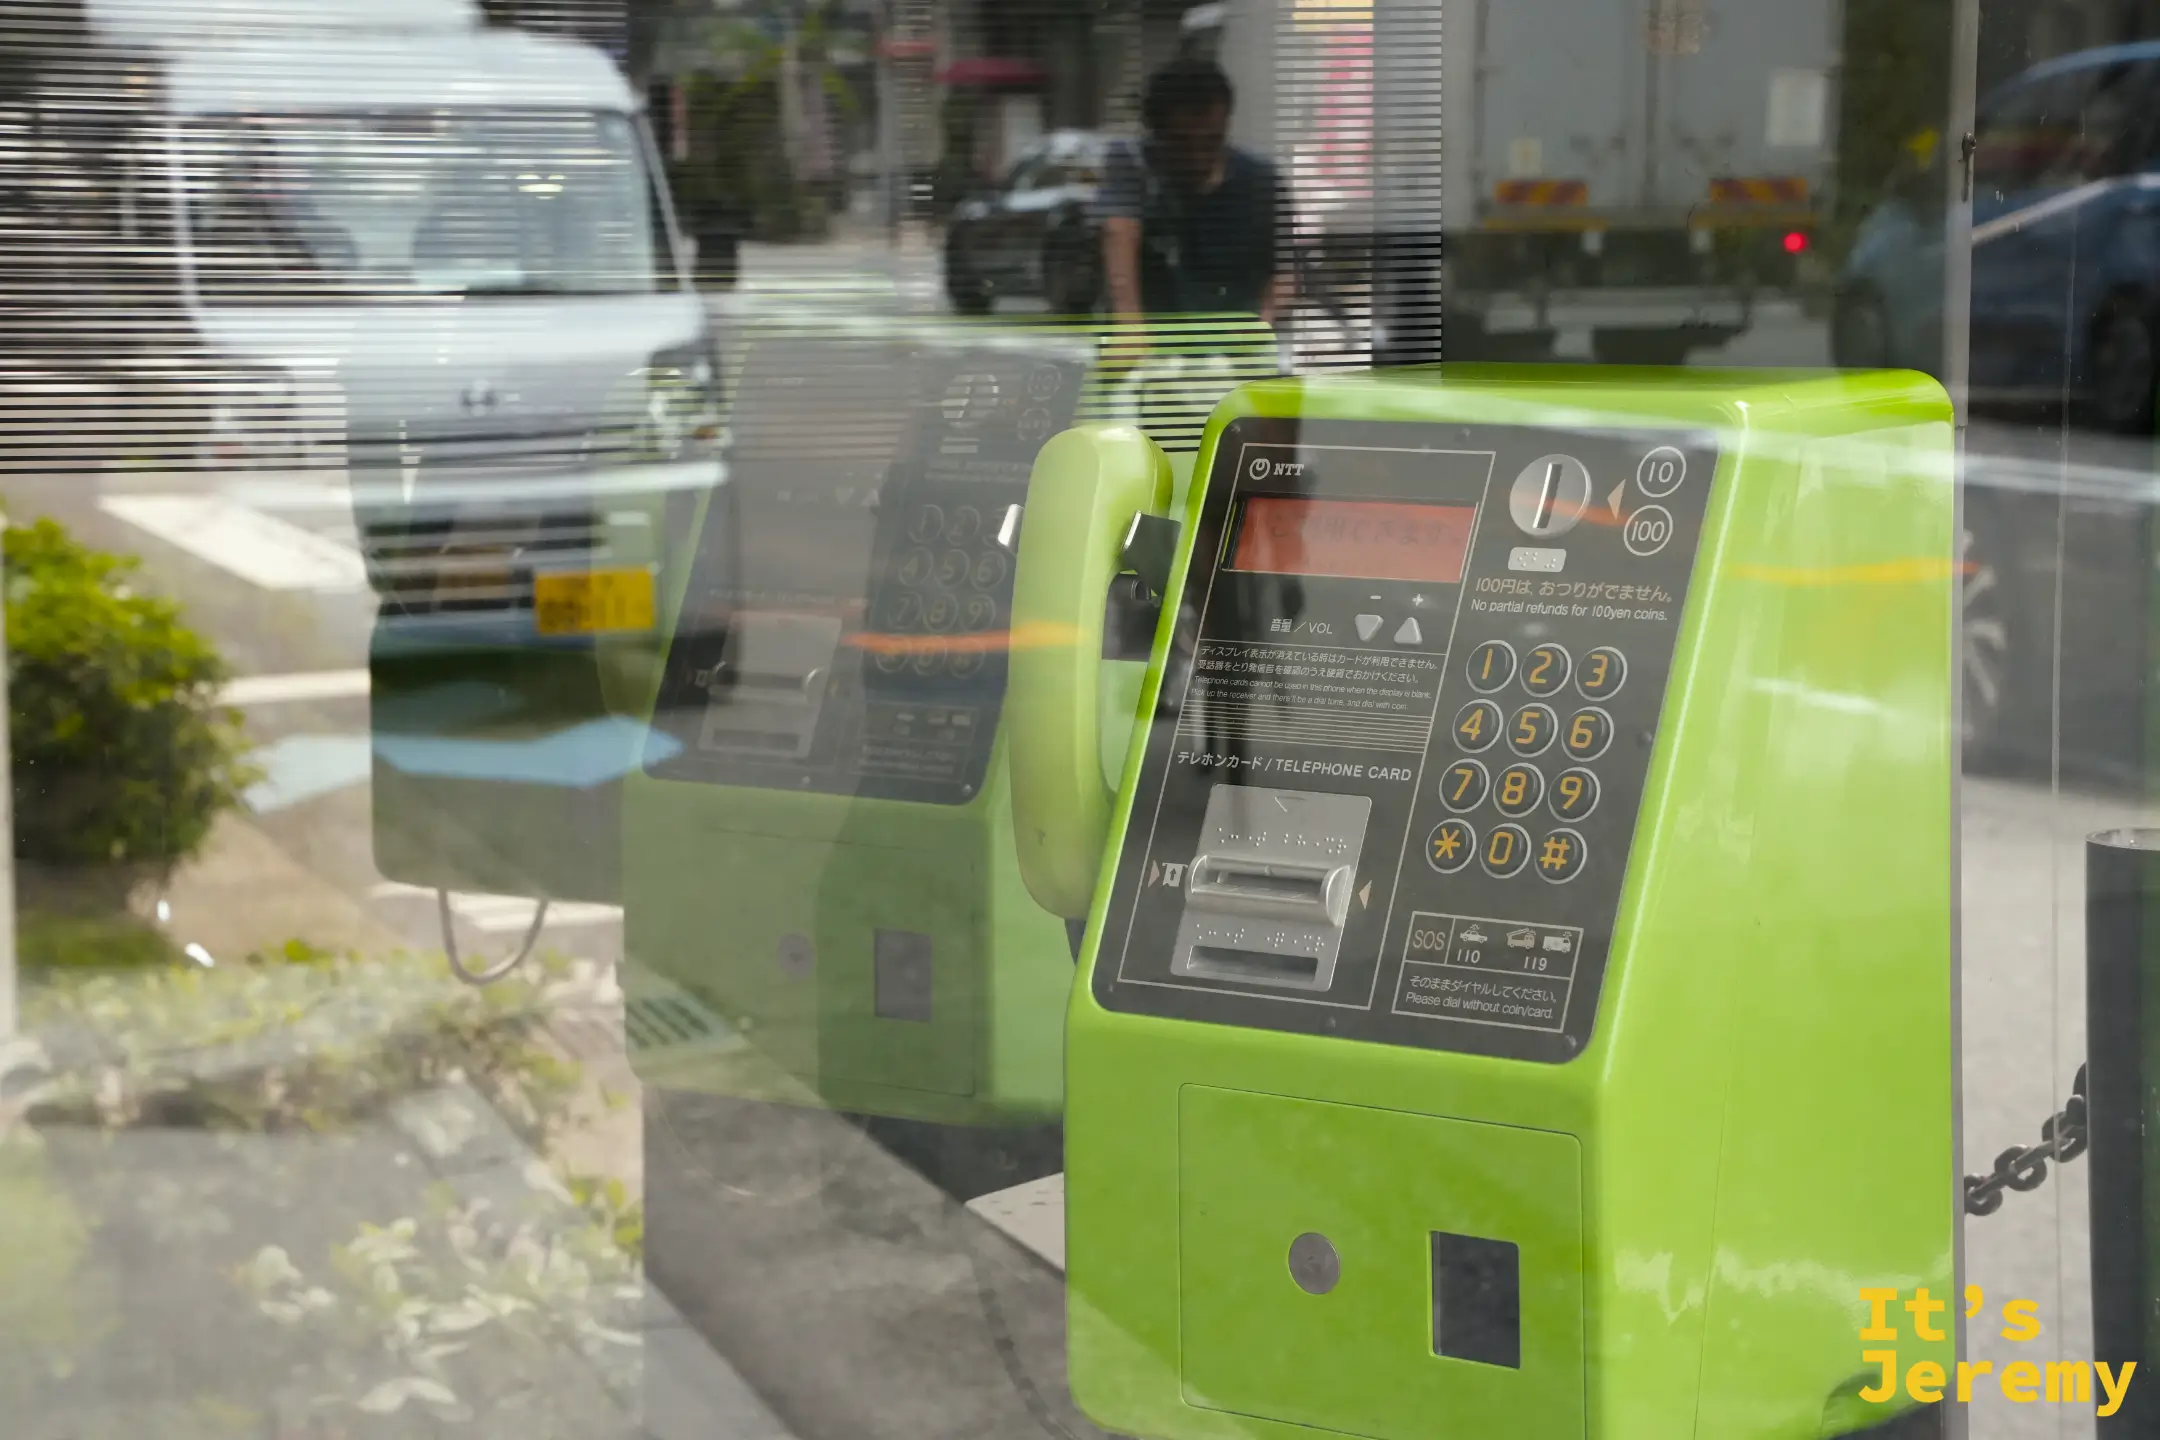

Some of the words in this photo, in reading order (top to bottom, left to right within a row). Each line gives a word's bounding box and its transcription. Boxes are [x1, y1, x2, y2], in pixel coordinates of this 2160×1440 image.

[1273, 463, 1305, 476] NTT
[1648, 461, 1674, 483] 10
[1630, 520, 1665, 542] 100
[1471, 599, 1487, 611] No
[1489, 600, 1524, 613] partial
[1526, 603, 1568, 616] refunds
[1571, 604, 1588, 616] for
[1591, 605, 1631, 620] 100yen
[1634, 608, 1668, 621] coins.
[1270, 618, 1292, 632] 音量
[1308, 622, 1333, 634] VOL
[1481, 648, 1493, 680] 1
[1528, 650, 1553, 684] 2
[1584, 654, 1609, 688] 3
[1194, 676, 1229, 686] Telephone
[1230, 678, 1248, 686] cards
[1250, 680, 1274, 688] cannot
[1310, 684, 1322, 692] this
[1322, 684, 1346, 694] phone
[1366, 686, 1378, 694] the
[1378, 688, 1403, 698] display
[1258, 692, 1272, 700] and
[1376, 700, 1390, 708] with
[1459, 708, 1484, 741] 4
[1515, 711, 1540, 744] 5
[1569, 715, 1596, 749] 6
[1177, 751, 1263, 770] テレホンカード
[1276, 758, 1364, 778] TELEPHONE
[1368, 766, 1412, 781] CARD
[1452, 768, 1474, 801] 7
[1501, 772, 1527, 806] 8
[1560, 776, 1583, 810] 9
[1488, 831, 1514, 865] 0
[1539, 836, 1570, 871] #
[1412, 929, 1446, 951] SOS
[1456, 948, 1481, 964] 110
[1524, 956, 1548, 972] 119
[1410, 976, 1557, 1004] そのままダイヤルしてください。
[1406, 992, 1441, 1006] Please
[1442, 996, 1461, 1008] dial
[1462, 998, 1500, 1013] without
[1502, 1003, 1553, 1019] coin/card.
